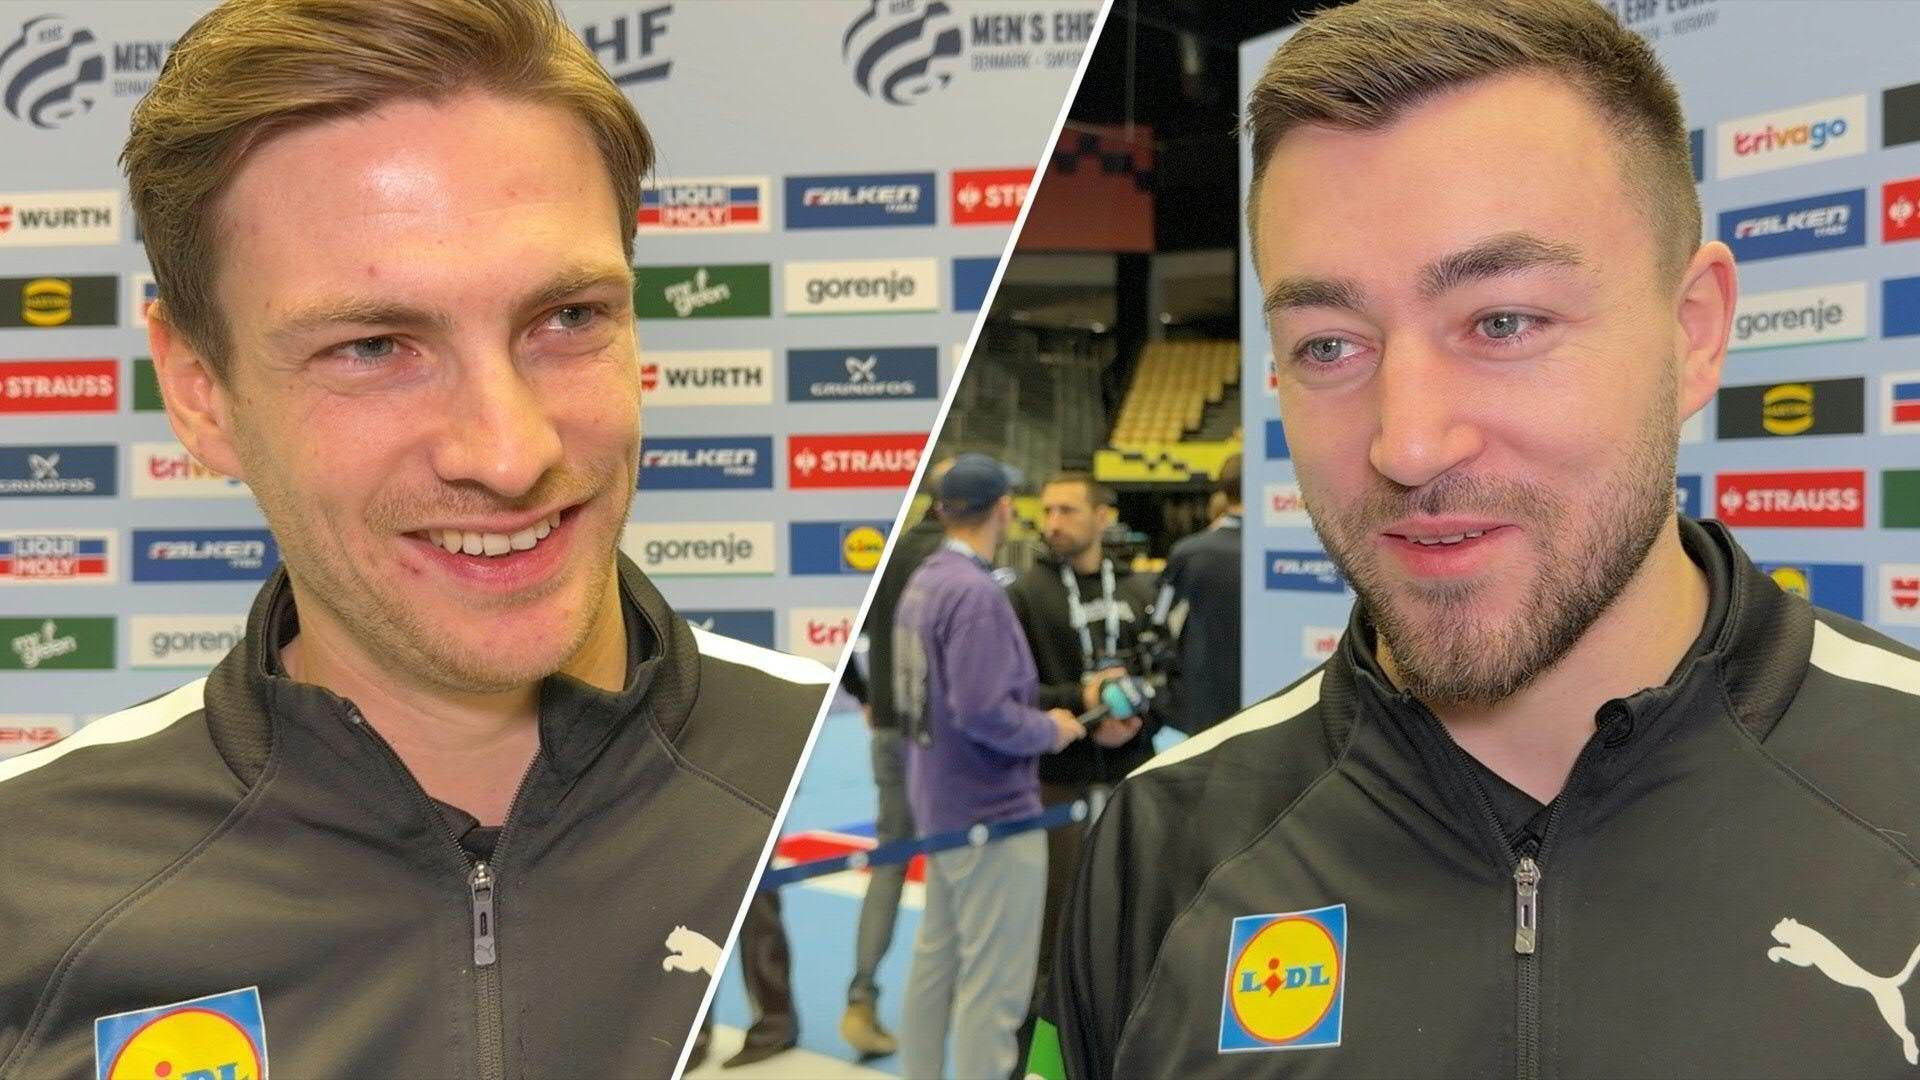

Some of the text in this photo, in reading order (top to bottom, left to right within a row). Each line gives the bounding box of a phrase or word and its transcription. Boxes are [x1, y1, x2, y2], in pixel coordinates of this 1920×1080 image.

[584, 4, 673, 63] HF
[972, 12, 1045, 45] MEN'S
[1734, 118, 1847, 156] trivago
[803, 185, 921, 206] FALKEN
[984, 182, 1031, 210] STR
[1735, 204, 1850, 239] FALKEN
[806, 271, 916, 303] gorenje
[1736, 299, 1843, 339] gorenje
[6, 374, 114, 399] STRAUSS
[642, 449, 758, 467] FALKEN
[821, 448, 923, 473] STRAUS
[1745, 487, 1858, 512] STRAUSS
[645, 531, 752, 563] gorenje
[806, 619, 850, 646] tri
